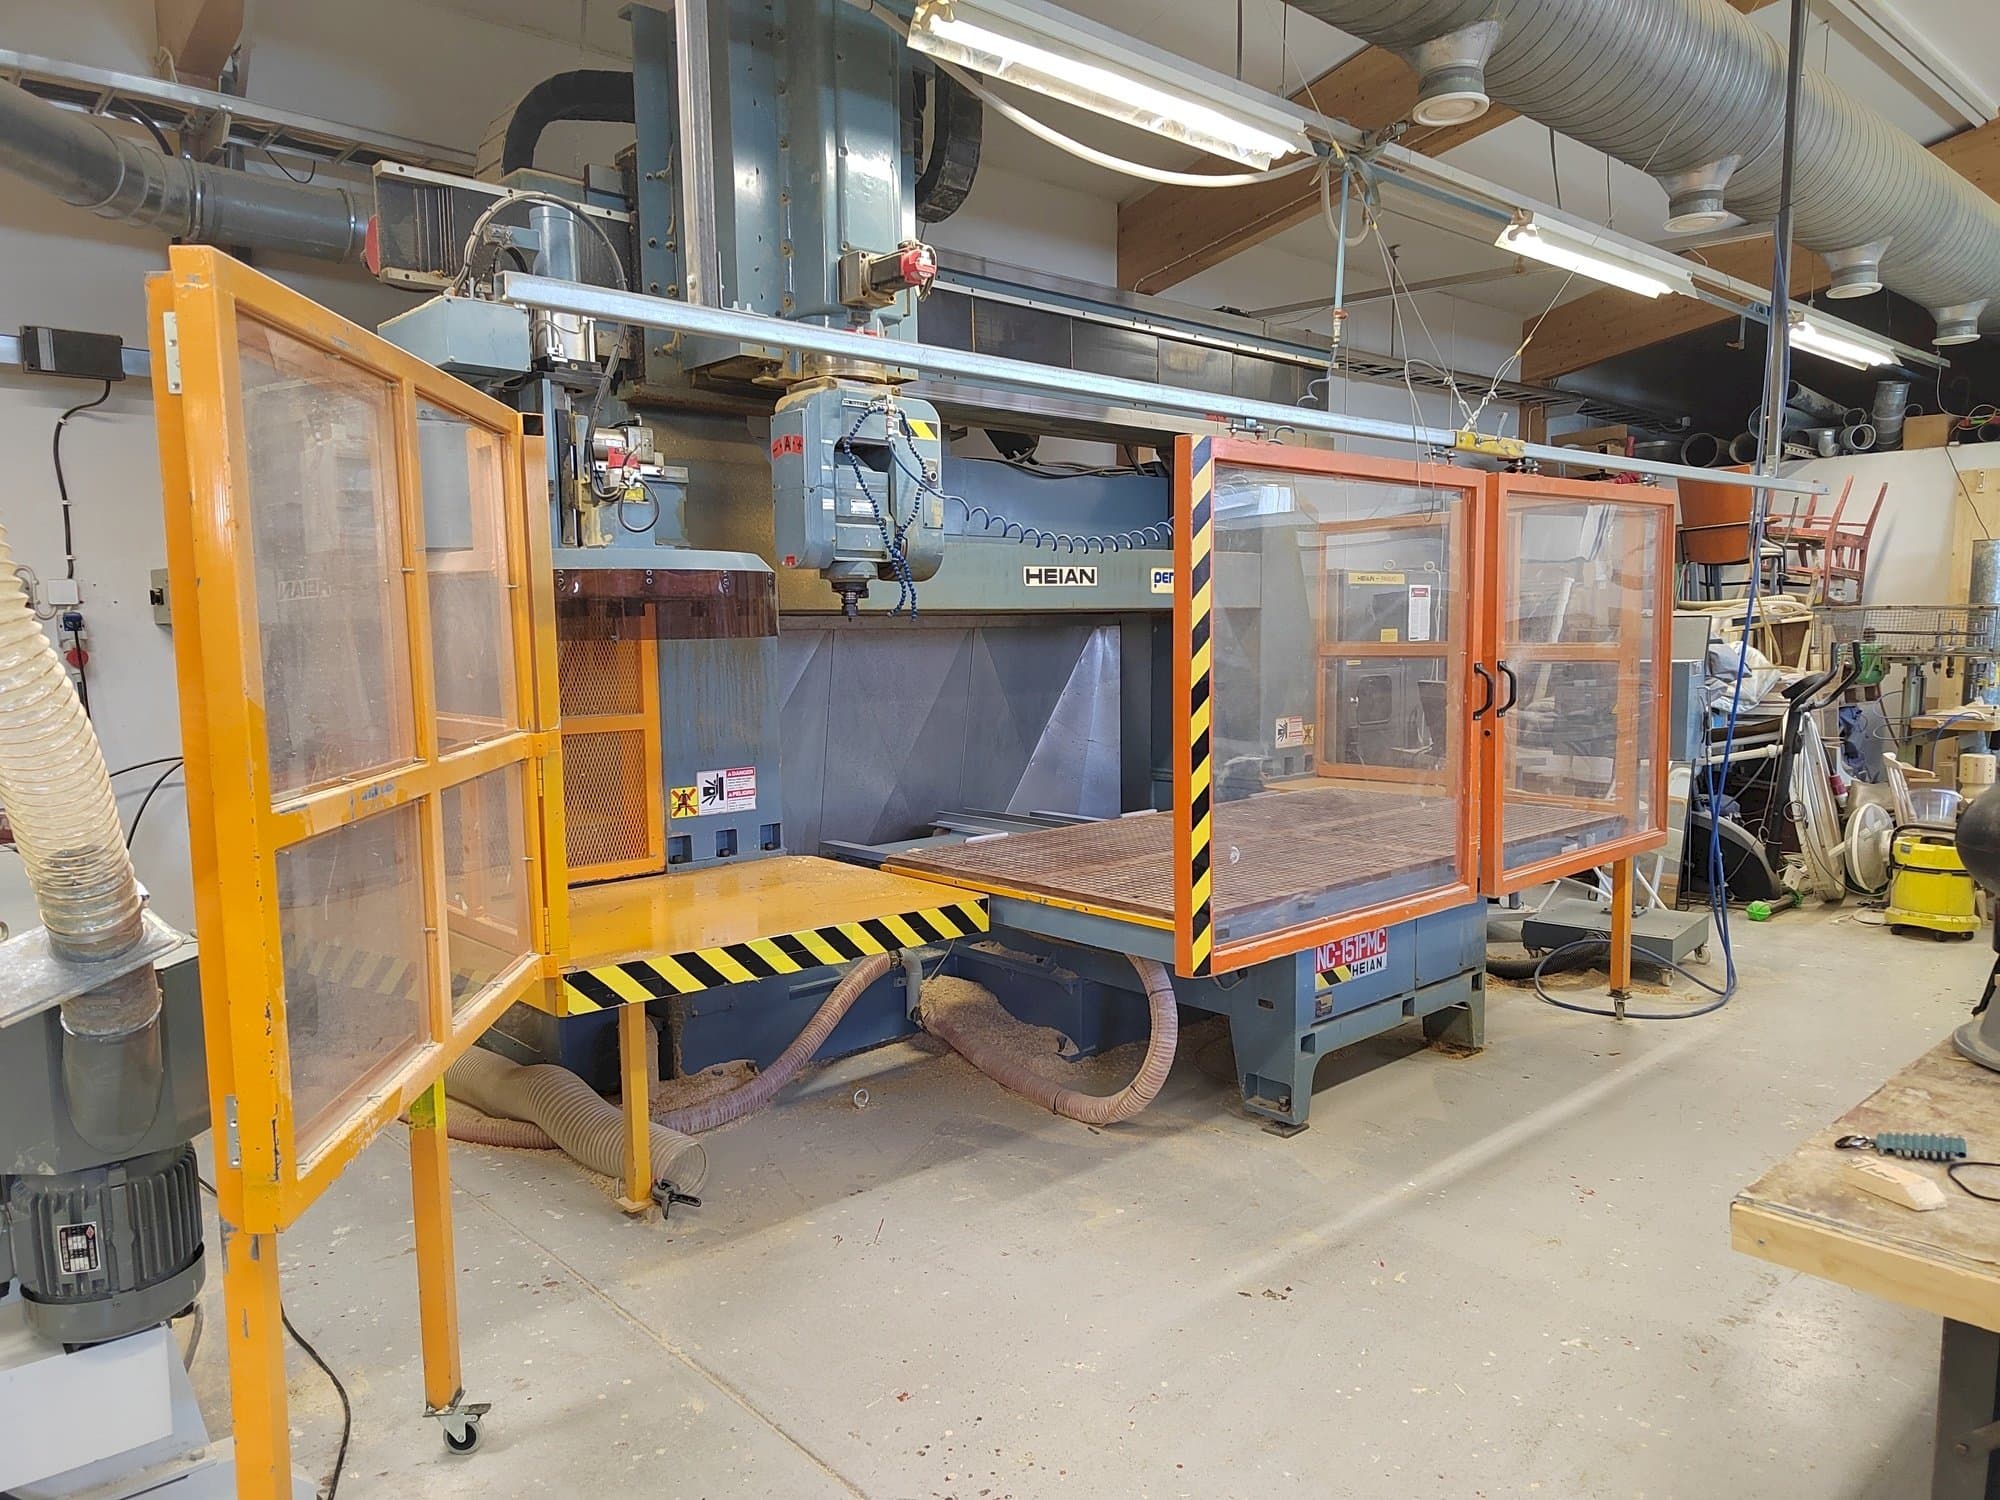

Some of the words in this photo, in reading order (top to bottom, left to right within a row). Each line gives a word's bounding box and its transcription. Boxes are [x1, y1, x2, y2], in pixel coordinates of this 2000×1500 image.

[1025, 568, 1095, 584] HEIAN
[1316, 928, 1386, 972] NC-151PMC
[1352, 956, 1383, 977] HEIAN
